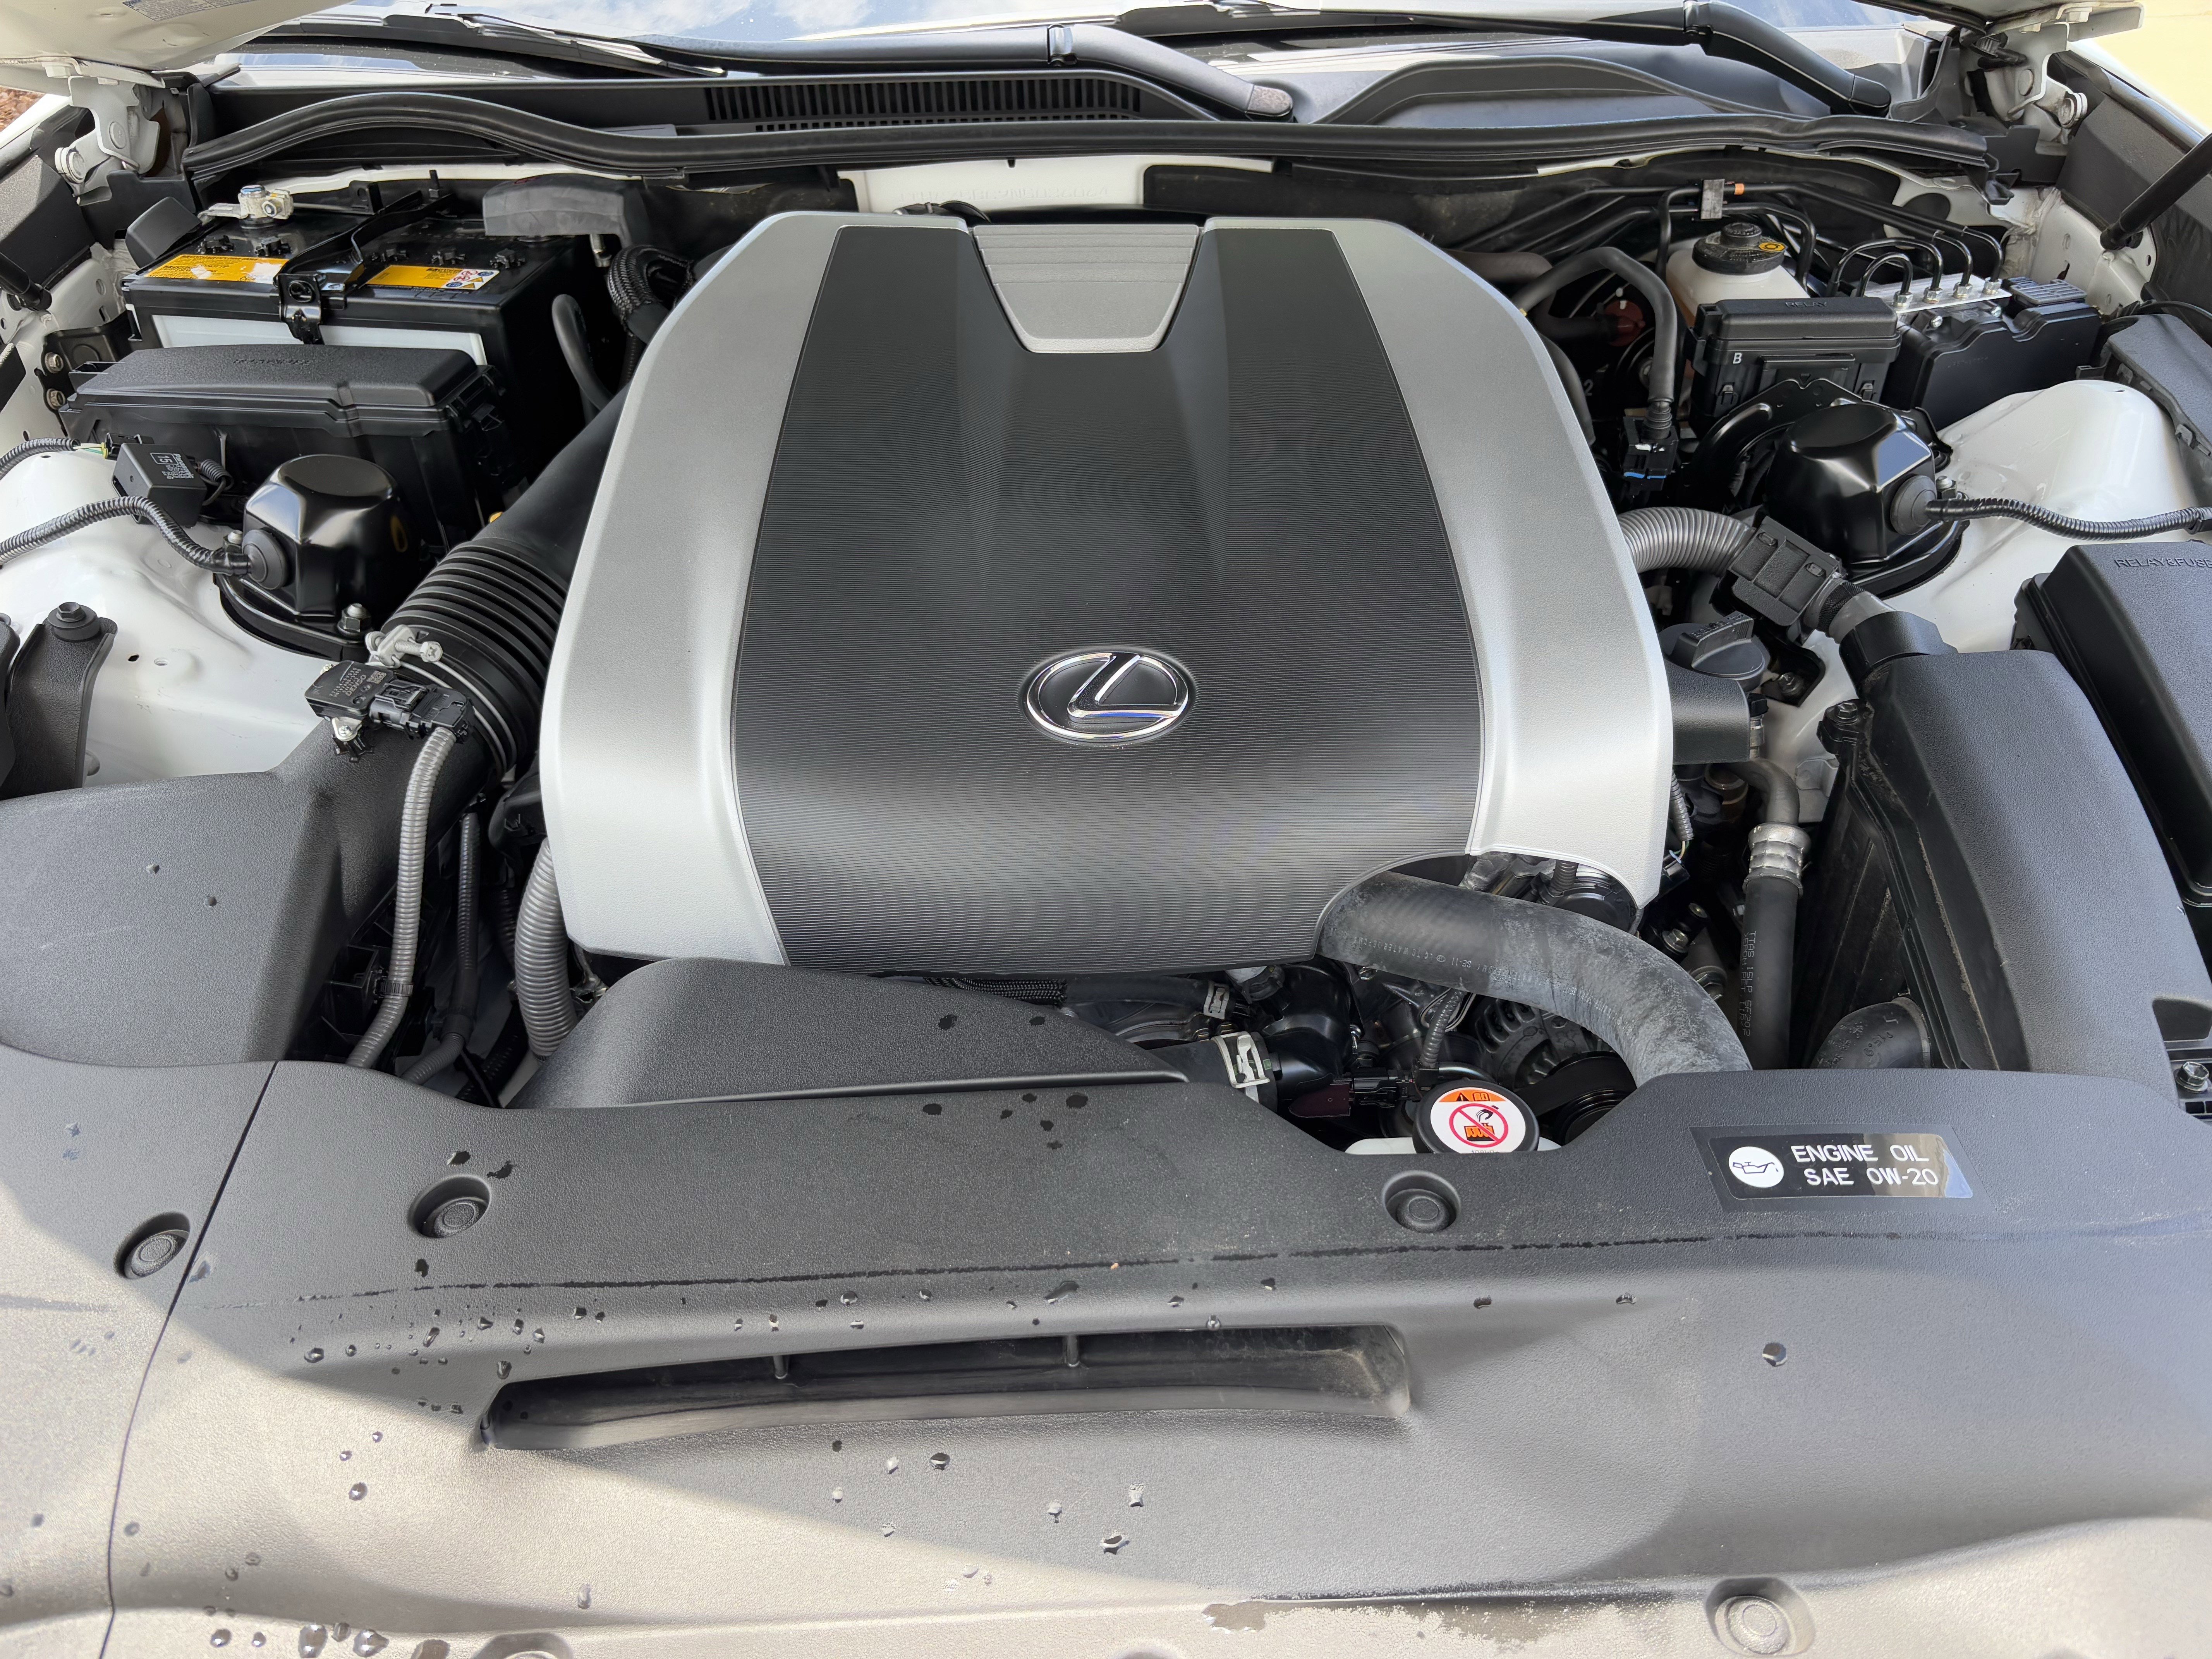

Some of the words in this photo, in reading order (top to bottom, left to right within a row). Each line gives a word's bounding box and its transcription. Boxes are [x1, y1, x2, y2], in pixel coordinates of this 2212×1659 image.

[1733, 353, 1742, 364] B
[345, 675, 367, 696] DENSO
[1748, 930, 1756, 958] TTAS
[1790, 1144, 1878, 1162] ENGINE
[1890, 1144, 1929, 1162] OIL
[1804, 1168, 1854, 1186] SAE
[1867, 1168, 1939, 1185] 0W-20
